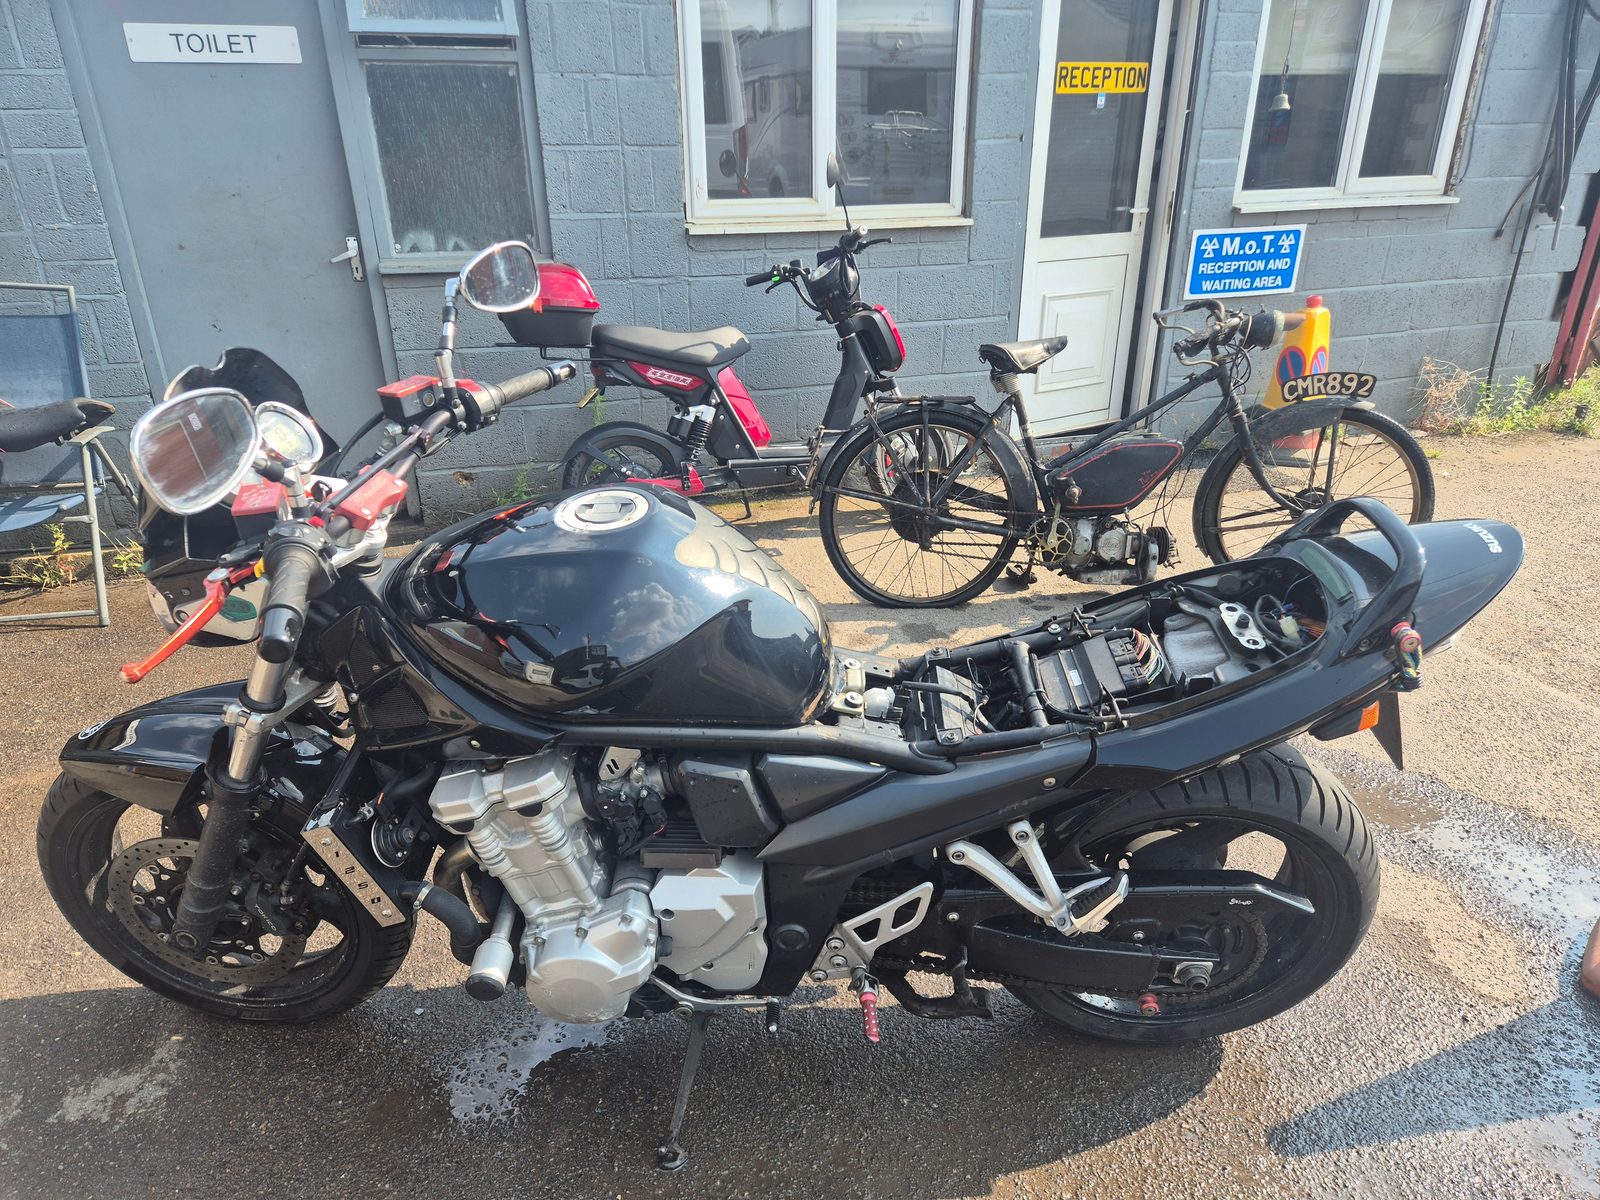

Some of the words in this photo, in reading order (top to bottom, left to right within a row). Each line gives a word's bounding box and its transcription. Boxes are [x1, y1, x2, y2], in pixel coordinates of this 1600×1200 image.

[169, 33, 257, 53] TOILET
[1058, 66, 1147, 88] RECEPTION
[1222, 235, 1275, 256] M.o.T.
[1198, 260, 1265, 274] RECEPTION
[1266, 258, 1291, 270] AND
[1201, 278, 1251, 291] WAITING
[1252, 276, 1282, 289] AREA
[1283, 373, 1374, 401] CMR892
[1463, 522, 1503, 553] SUZUKI
